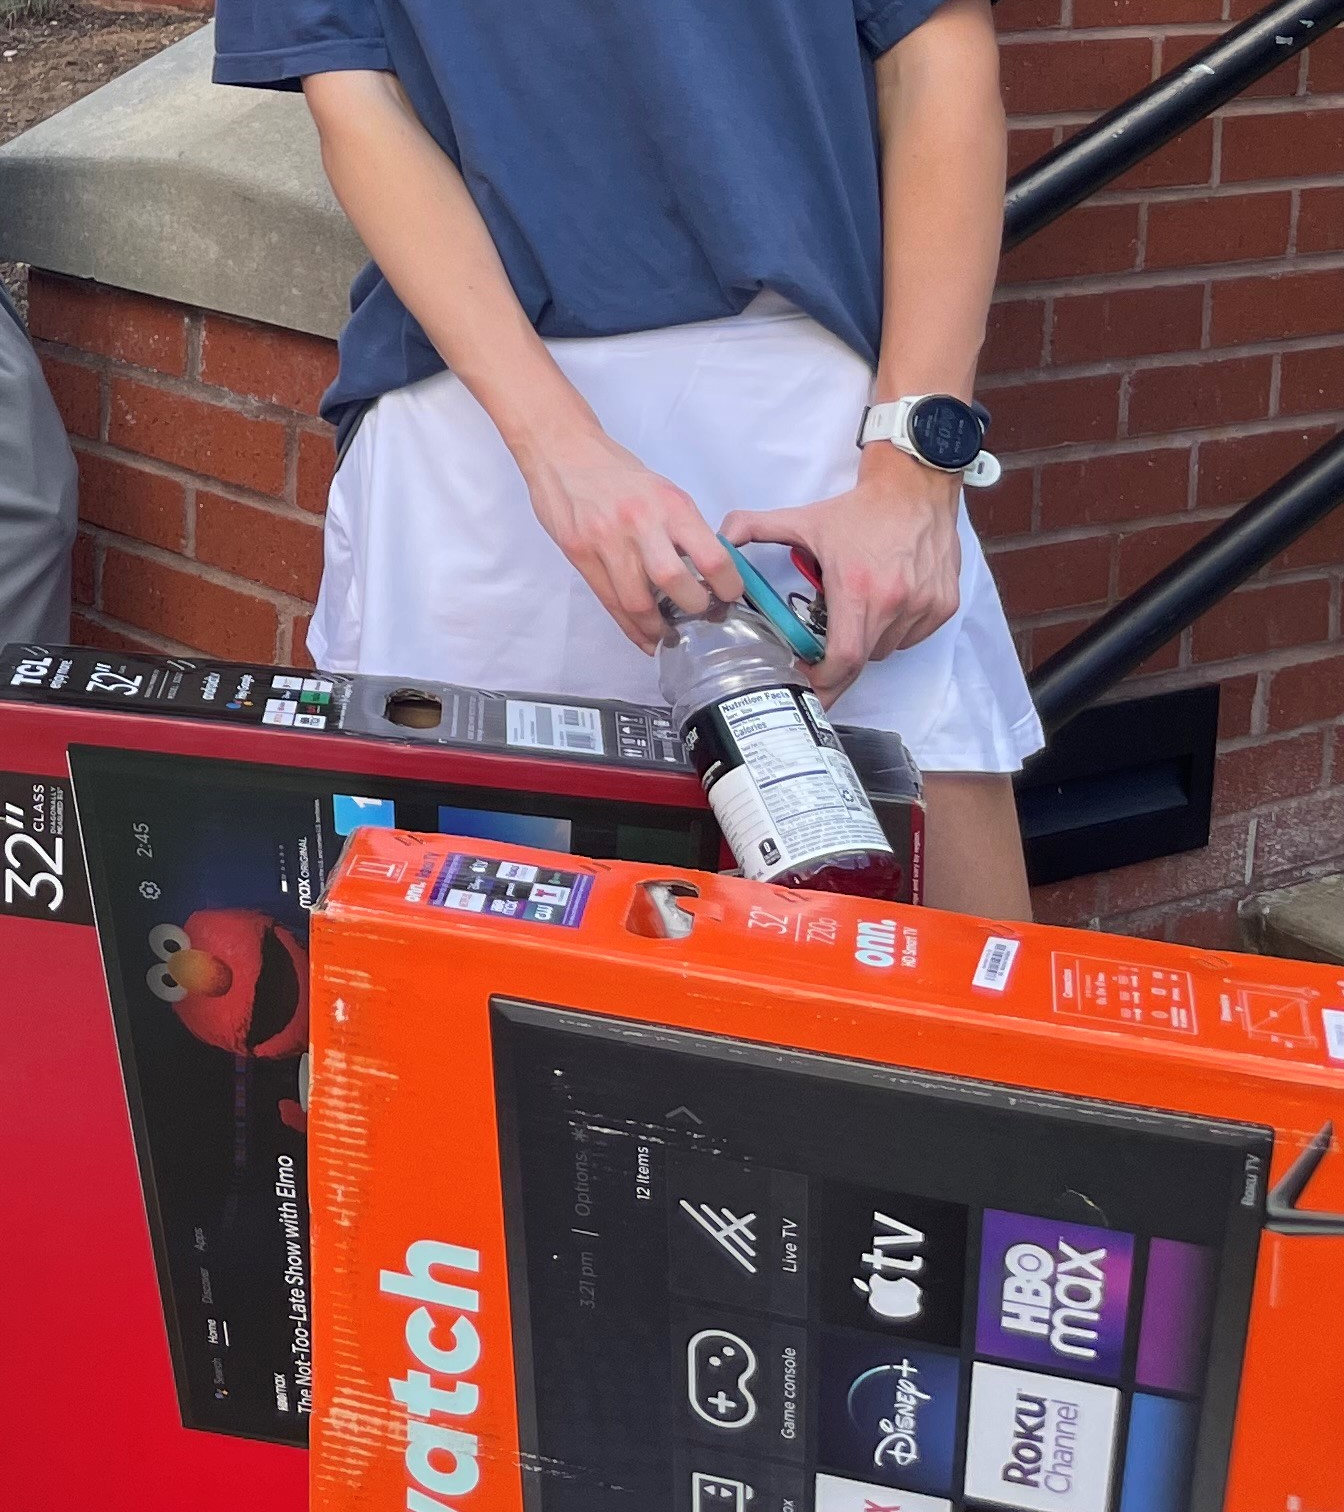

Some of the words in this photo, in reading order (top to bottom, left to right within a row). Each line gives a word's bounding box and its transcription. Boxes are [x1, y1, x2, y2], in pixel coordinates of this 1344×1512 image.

[10, 657, 54, 686] TCL
[86, 662, 144, 697] 32"
[721, 695, 763, 714] Nutrition
[765, 690, 791, 701] Facts
[733, 721, 768, 738] Calories
[792, 712, 802, 724] 0
[32, 784, 45, 833] CLASS
[50, 786, 58, 835] DIAGONALLY
[4, 802, 64, 911] 32"
[132, 822, 154, 859] 2:45
[299, 836, 308, 877] ORIGINAL
[297, 878, 313, 910] max
[747, 905, 789, 935] 32"
[805, 917, 838, 945] 720p
[903, 927, 918, 938] TV
[854, 919, 898, 968] onn.
[903, 938, 918, 956] Smart
[902, 956, 917, 968] HD
[275, 1154, 297, 1200] Elmo
[636, 1146, 651, 1185] Items
[1246, 1154, 1260, 1172] TV
[574, 1152, 593, 1218] Options
[636, 1187, 651, 1201] 12
[278, 1202, 299, 1238] with
[781, 1218, 798, 1237] TV
[194, 1226, 207, 1252] Apps
[782, 1238, 798, 1274] Live
[861, 1211, 926, 1272] tv
[284, 1240, 305, 1286] Show
[582, 1250, 601, 1281] pm
[200, 1267, 213, 1304] Discover
[1000, 1243, 1056, 1335] HBO
[1049, 1240, 1109, 1360] max
[207, 1318, 219, 1344] Home
[288, 1289, 312, 1387] Not-Too-Late
[212, 1357, 224, 1384] Search
[379, 1239, 481, 1512] atch
[783, 1346, 797, 1403] console
[297, 1388, 312, 1414] The
[780, 1403, 795, 1441] Game
[1043, 1399, 1081, 1495] Channel
